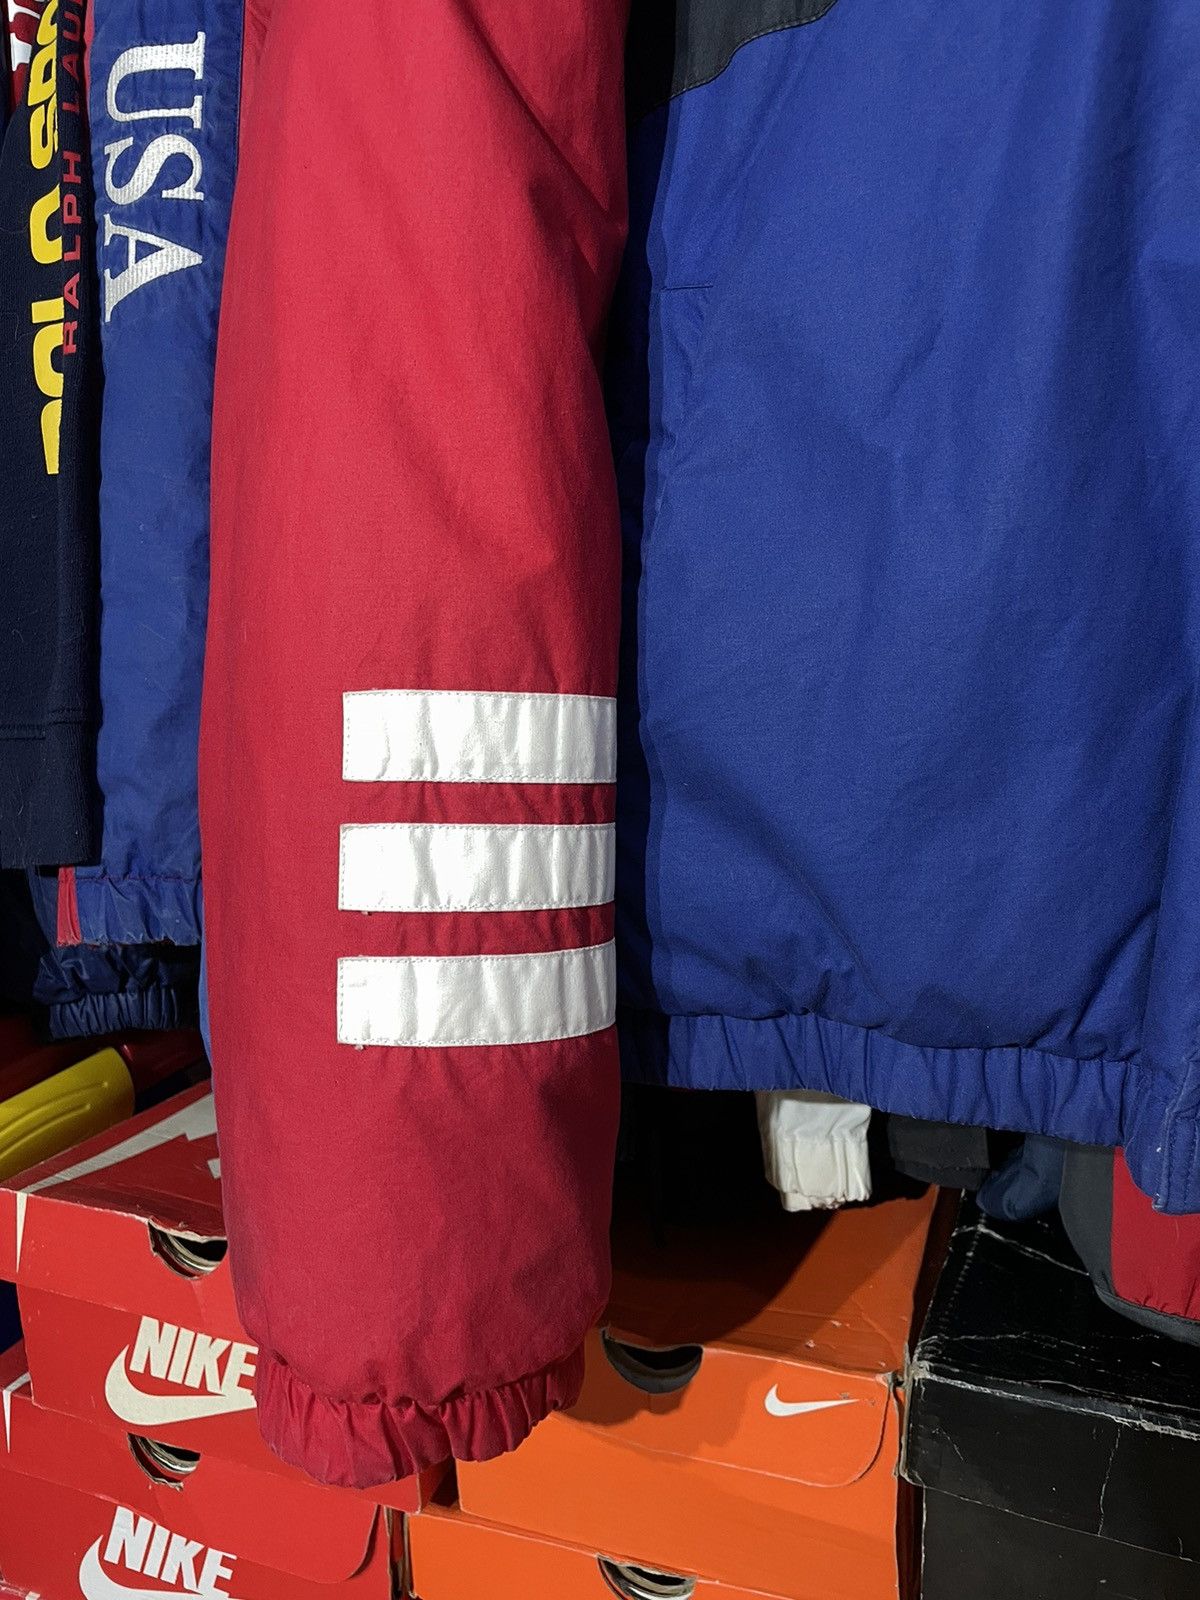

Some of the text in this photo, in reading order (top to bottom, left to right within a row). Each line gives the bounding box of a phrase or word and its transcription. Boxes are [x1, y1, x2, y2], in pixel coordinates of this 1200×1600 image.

[61, 0, 84, 355] RALPH LAU
[104, 31, 206, 323] USA
[130, 1315, 259, 1397] NIKE
[104, 1505, 237, 1599] NIKE
